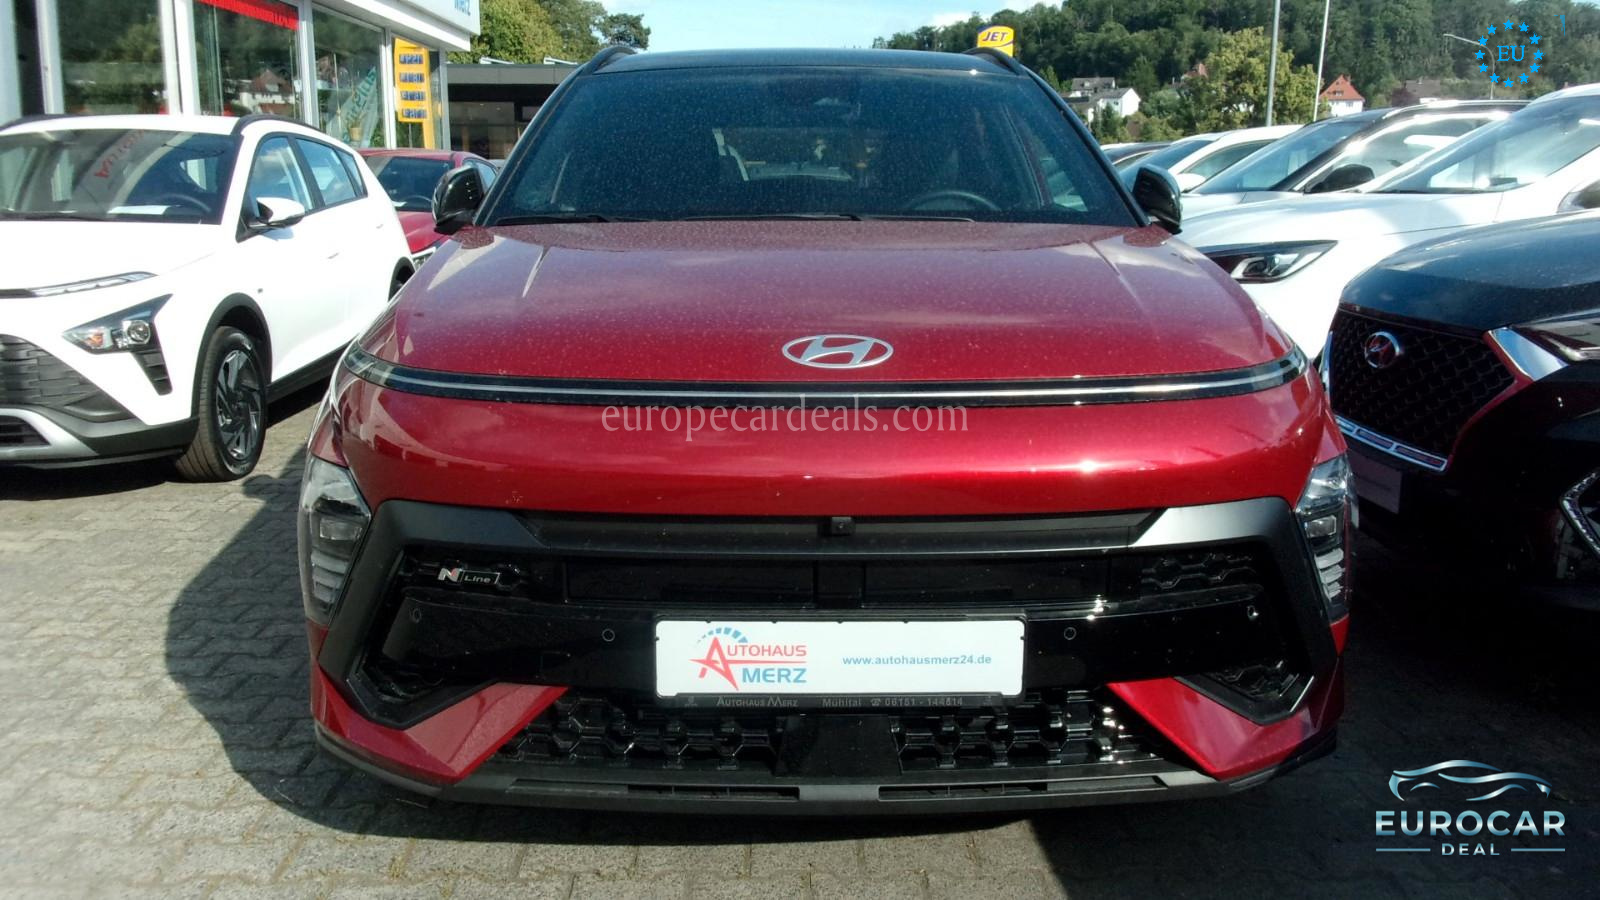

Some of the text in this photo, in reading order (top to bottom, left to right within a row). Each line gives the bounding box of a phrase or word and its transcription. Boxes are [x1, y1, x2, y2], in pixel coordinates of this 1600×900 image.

[982, 31, 1008, 42] JET
[438, 567, 491, 584] N Line
[842, 653, 992, 665] www.autohausmerz24.de
[742, 667, 807, 683] MERZ
